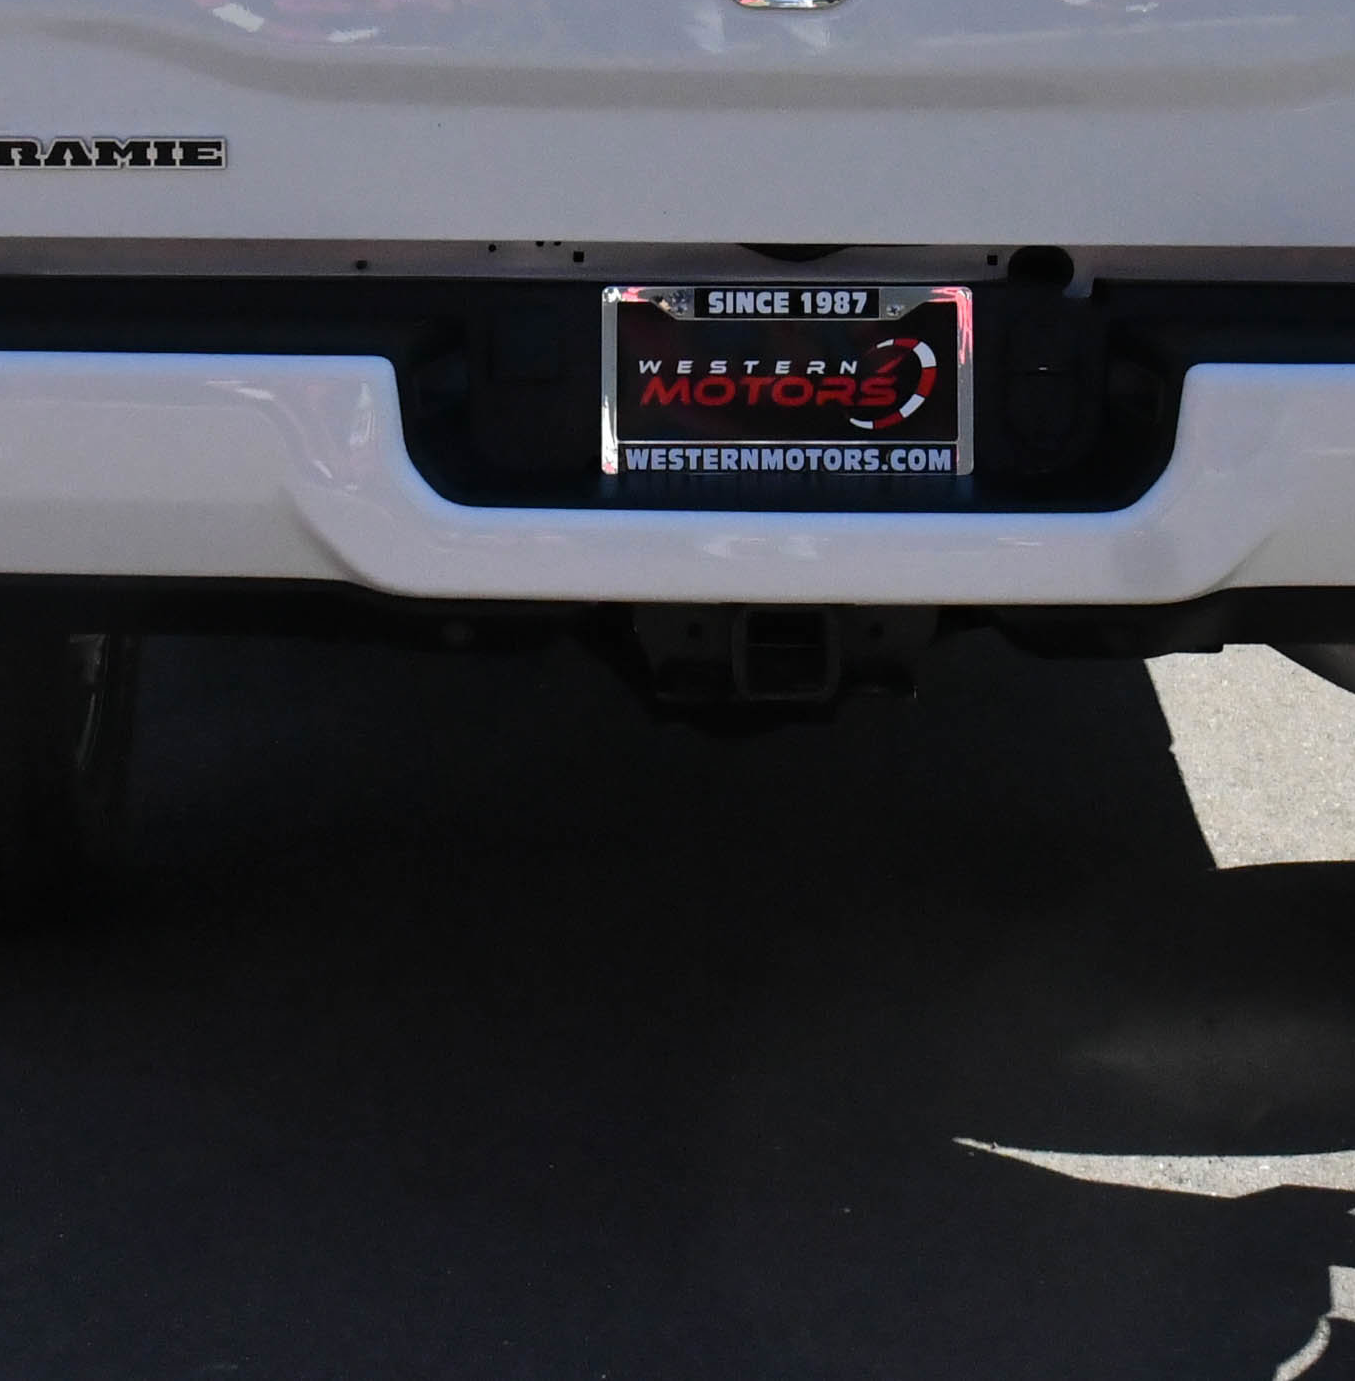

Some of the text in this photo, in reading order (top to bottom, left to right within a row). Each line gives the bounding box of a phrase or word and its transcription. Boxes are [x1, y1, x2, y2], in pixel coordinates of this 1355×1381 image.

[708, 291, 868, 314] SINCE 1987
[638, 360, 858, 375] WESTERN
[640, 377, 900, 407] MOTORS
[625, 448, 952, 471] WESTERNMOTORS.COM
